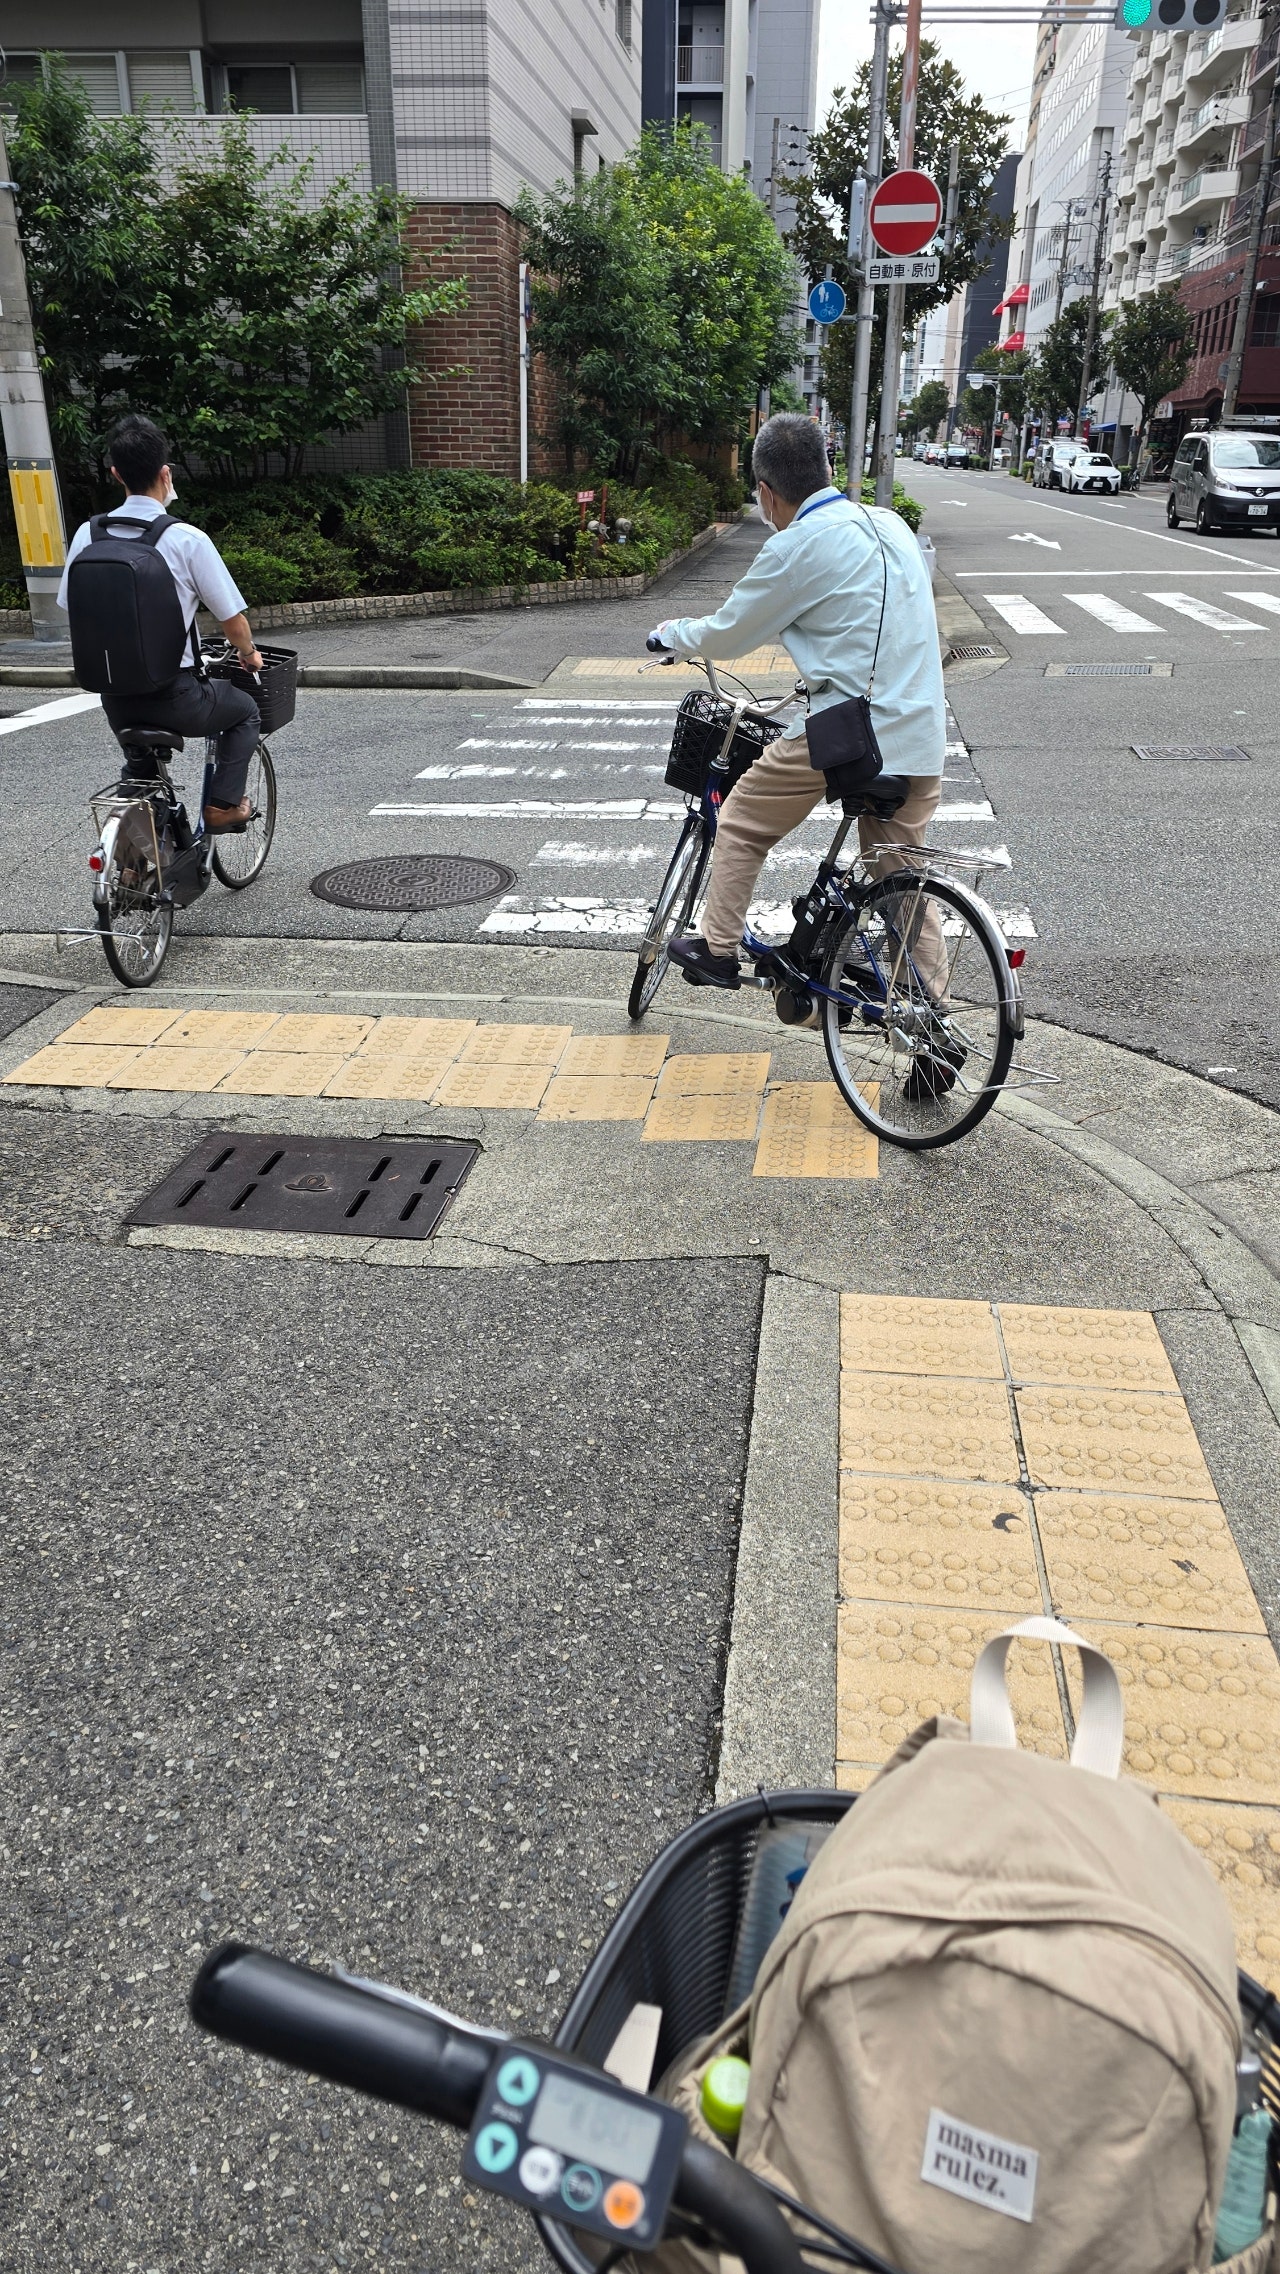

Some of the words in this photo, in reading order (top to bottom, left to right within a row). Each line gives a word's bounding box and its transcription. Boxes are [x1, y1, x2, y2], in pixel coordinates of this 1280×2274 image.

[869, 262, 936, 279] 自動車・原付
[934, 2151, 1005, 2197] rulez.
[938, 2124, 1027, 2178] masma
